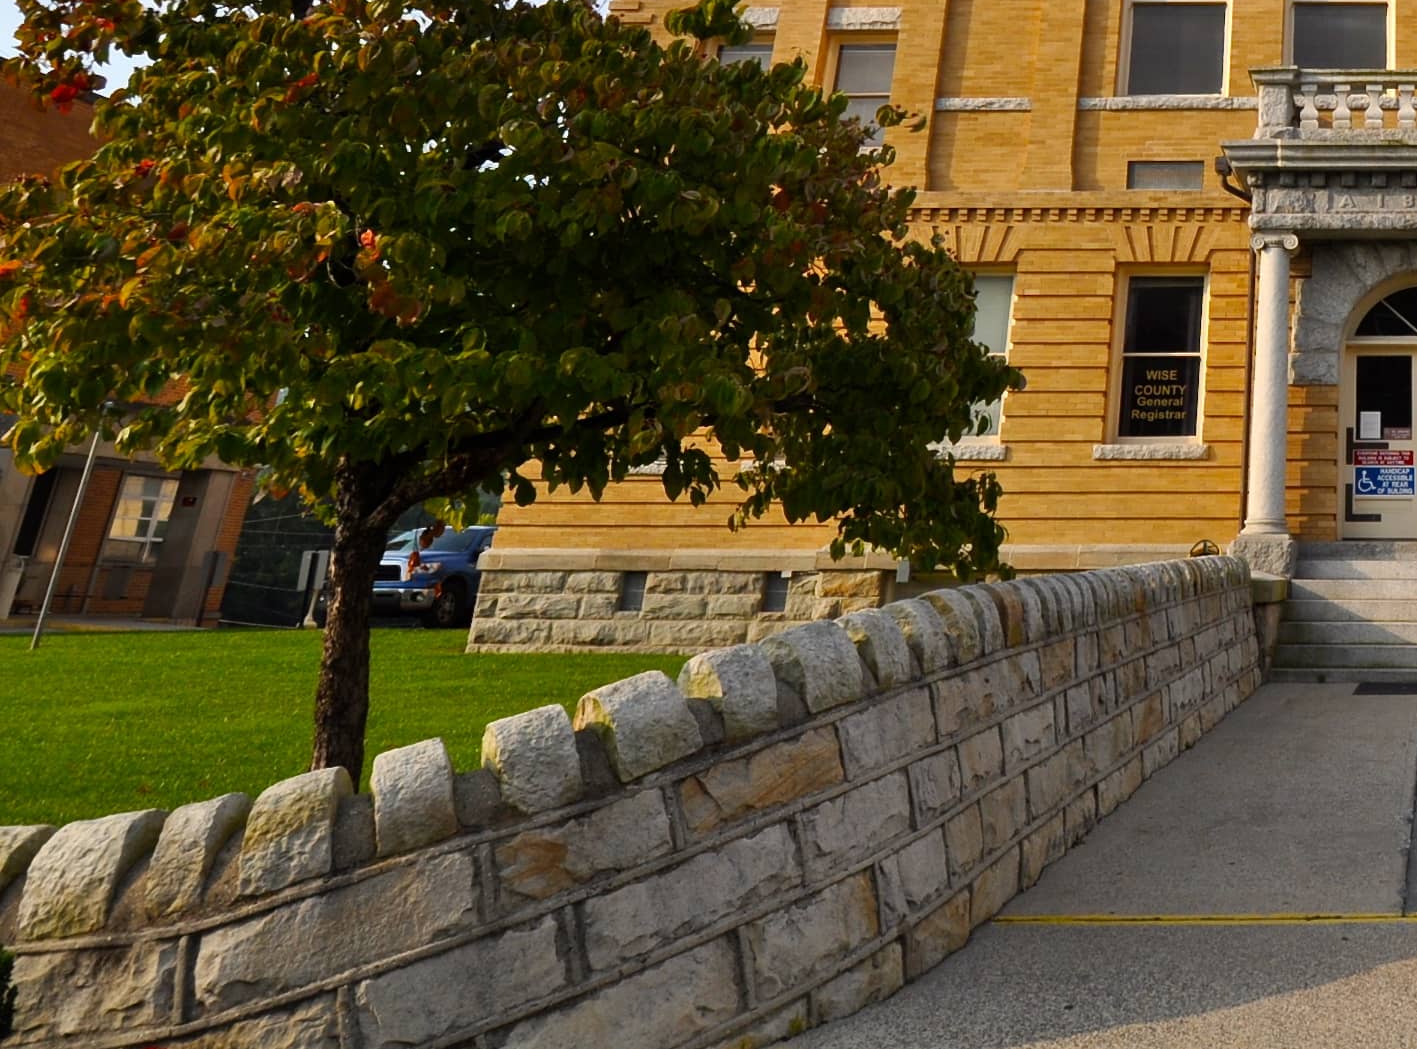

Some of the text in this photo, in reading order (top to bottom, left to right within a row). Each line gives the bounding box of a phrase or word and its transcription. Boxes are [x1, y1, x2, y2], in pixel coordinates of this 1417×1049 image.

[1338, 193, 1357, 208] A
[1146, 370, 1178, 381] WISE
[1134, 385, 1186, 395] COUNTY
[1137, 396, 1184, 407] General
[1131, 409, 1187, 421] Registrar
